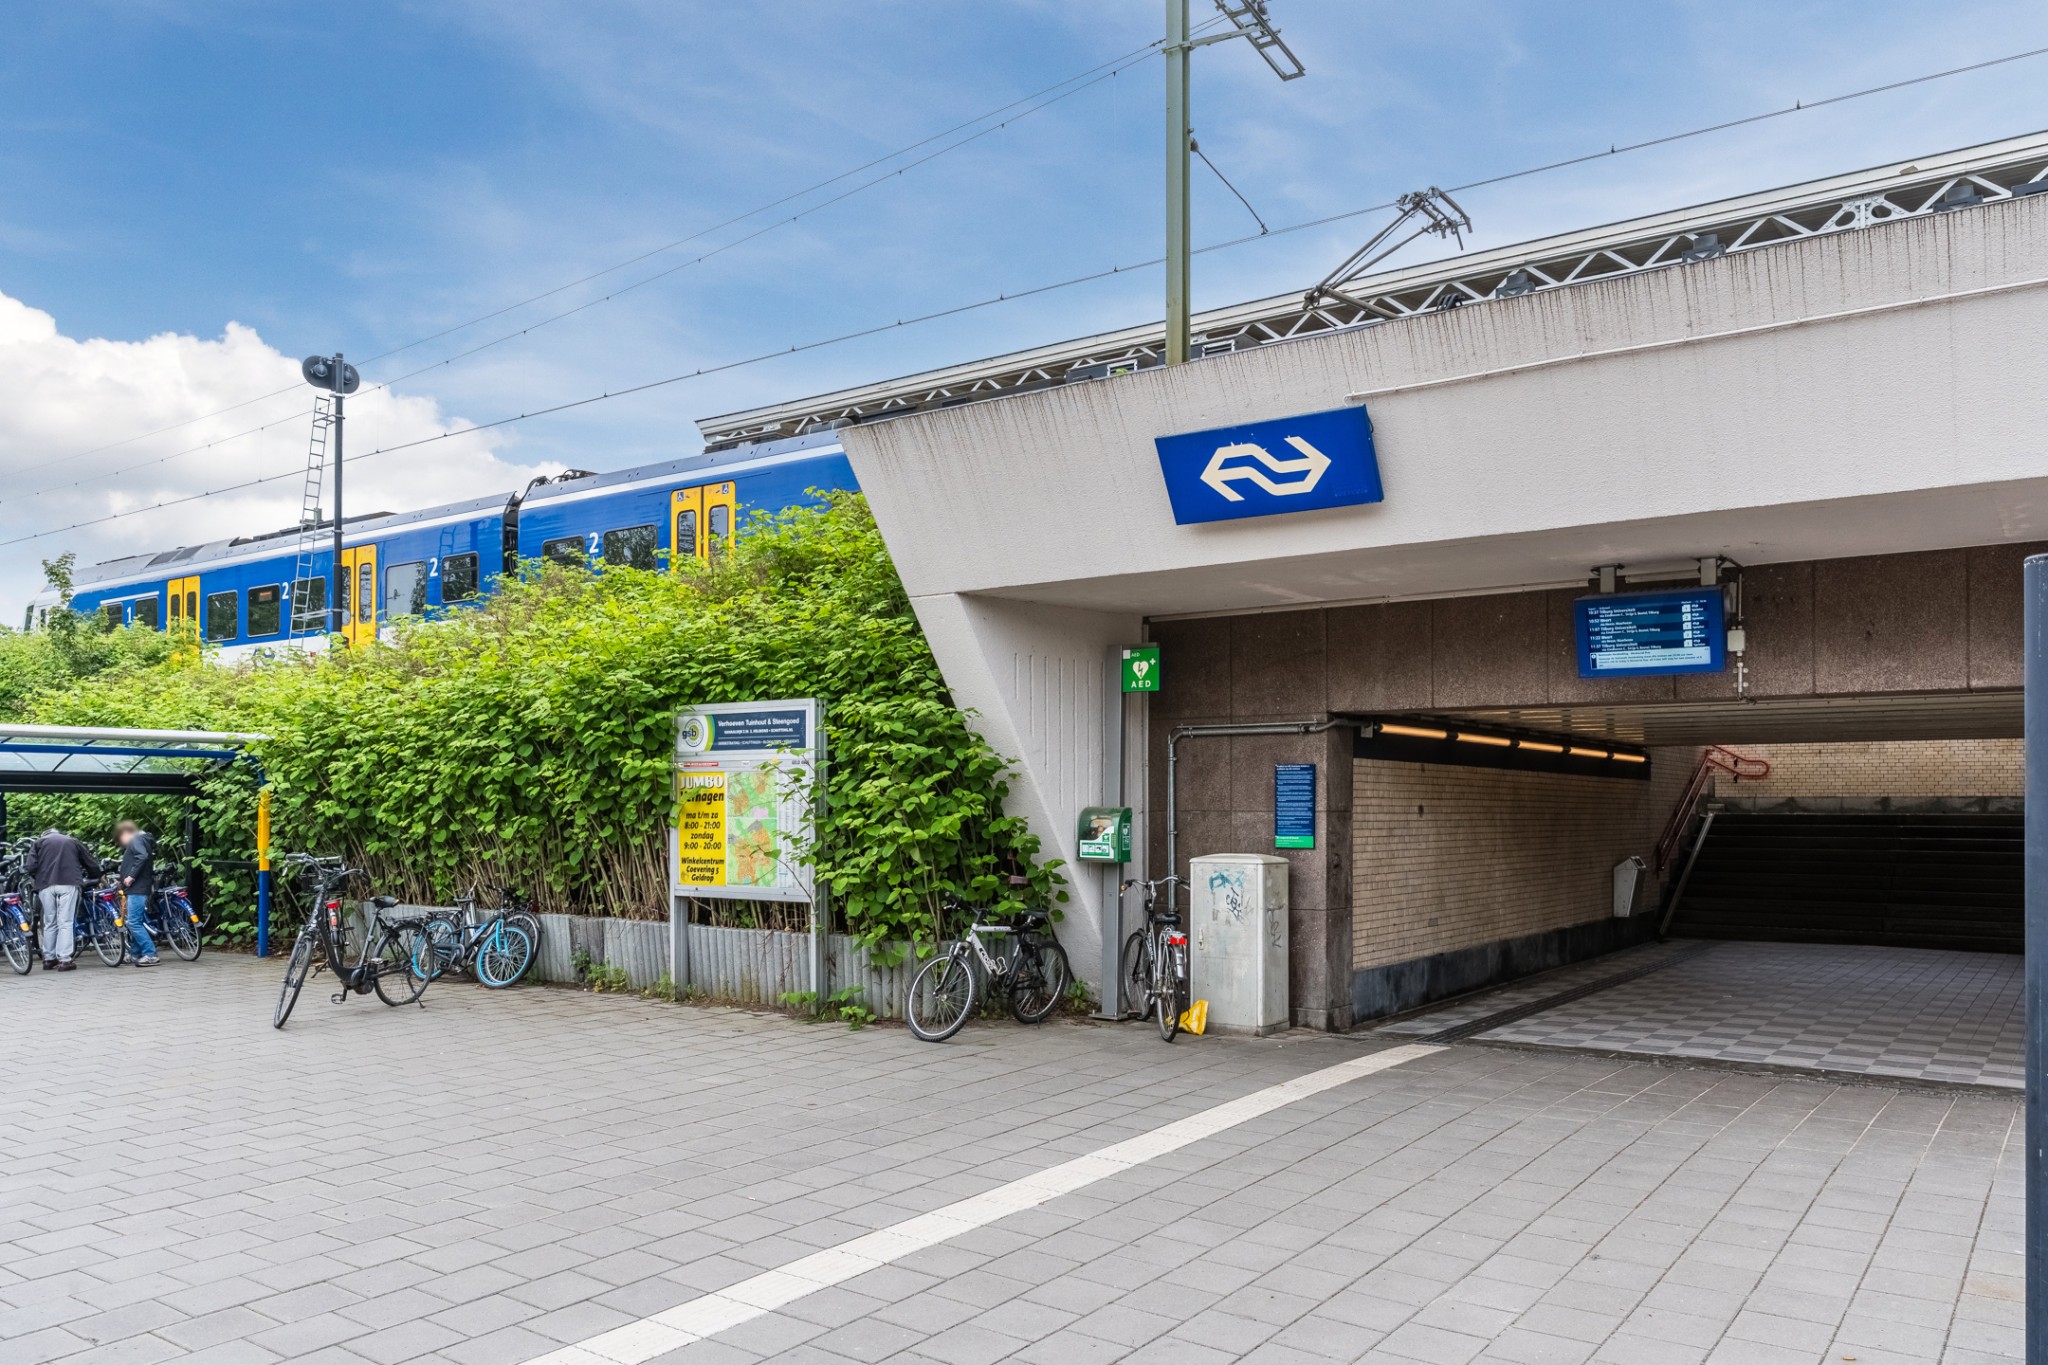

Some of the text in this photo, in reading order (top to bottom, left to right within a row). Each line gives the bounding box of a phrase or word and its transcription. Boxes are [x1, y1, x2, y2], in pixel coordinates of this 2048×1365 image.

[589, 532, 599, 553] 2
[429, 557, 438, 576] 2
[282, 582, 289, 599] 2
[127, 607, 132, 623] 1
[1131, 680, 1152, 689] AED
[772, 717, 800, 725] Steengoed
[682, 728, 697, 740] gsb
[680, 775, 724, 789] JUMBO
[697, 811, 710, 819] t/m
[684, 821, 699, 829] 8:00
[703, 821, 721, 829] 21:00
[690, 831, 714, 842] zondag
[684, 842, 699, 850] 9:00
[703, 842, 722, 850] 20:00
[681, 857, 725, 865] Winkelcentrum
[686, 865, 715, 875] Coevering
[691, 874, 714, 883] Geldrop
